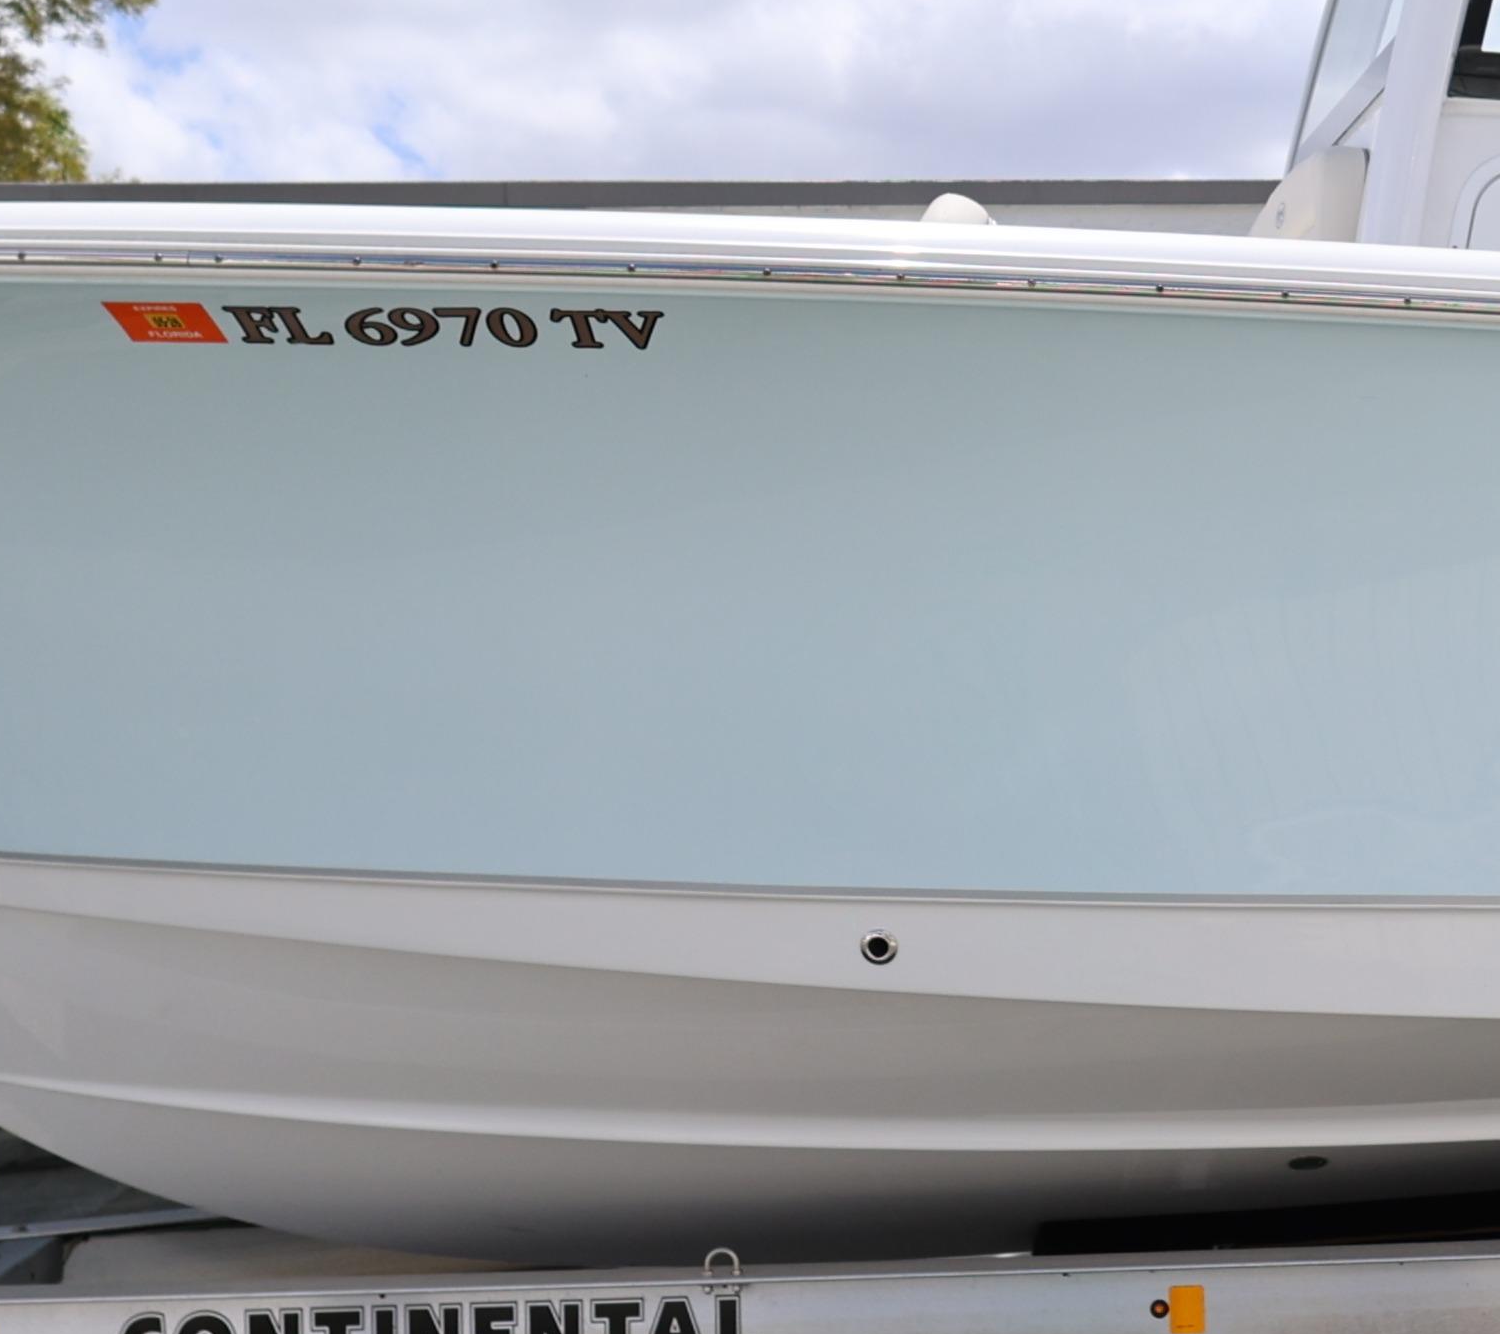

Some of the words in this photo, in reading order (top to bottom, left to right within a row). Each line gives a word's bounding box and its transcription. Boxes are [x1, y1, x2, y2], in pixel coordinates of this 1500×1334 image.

[221, 305, 335, 346] FL
[344, 307, 538, 348] 6970
[549, 308, 665, 350] TV
